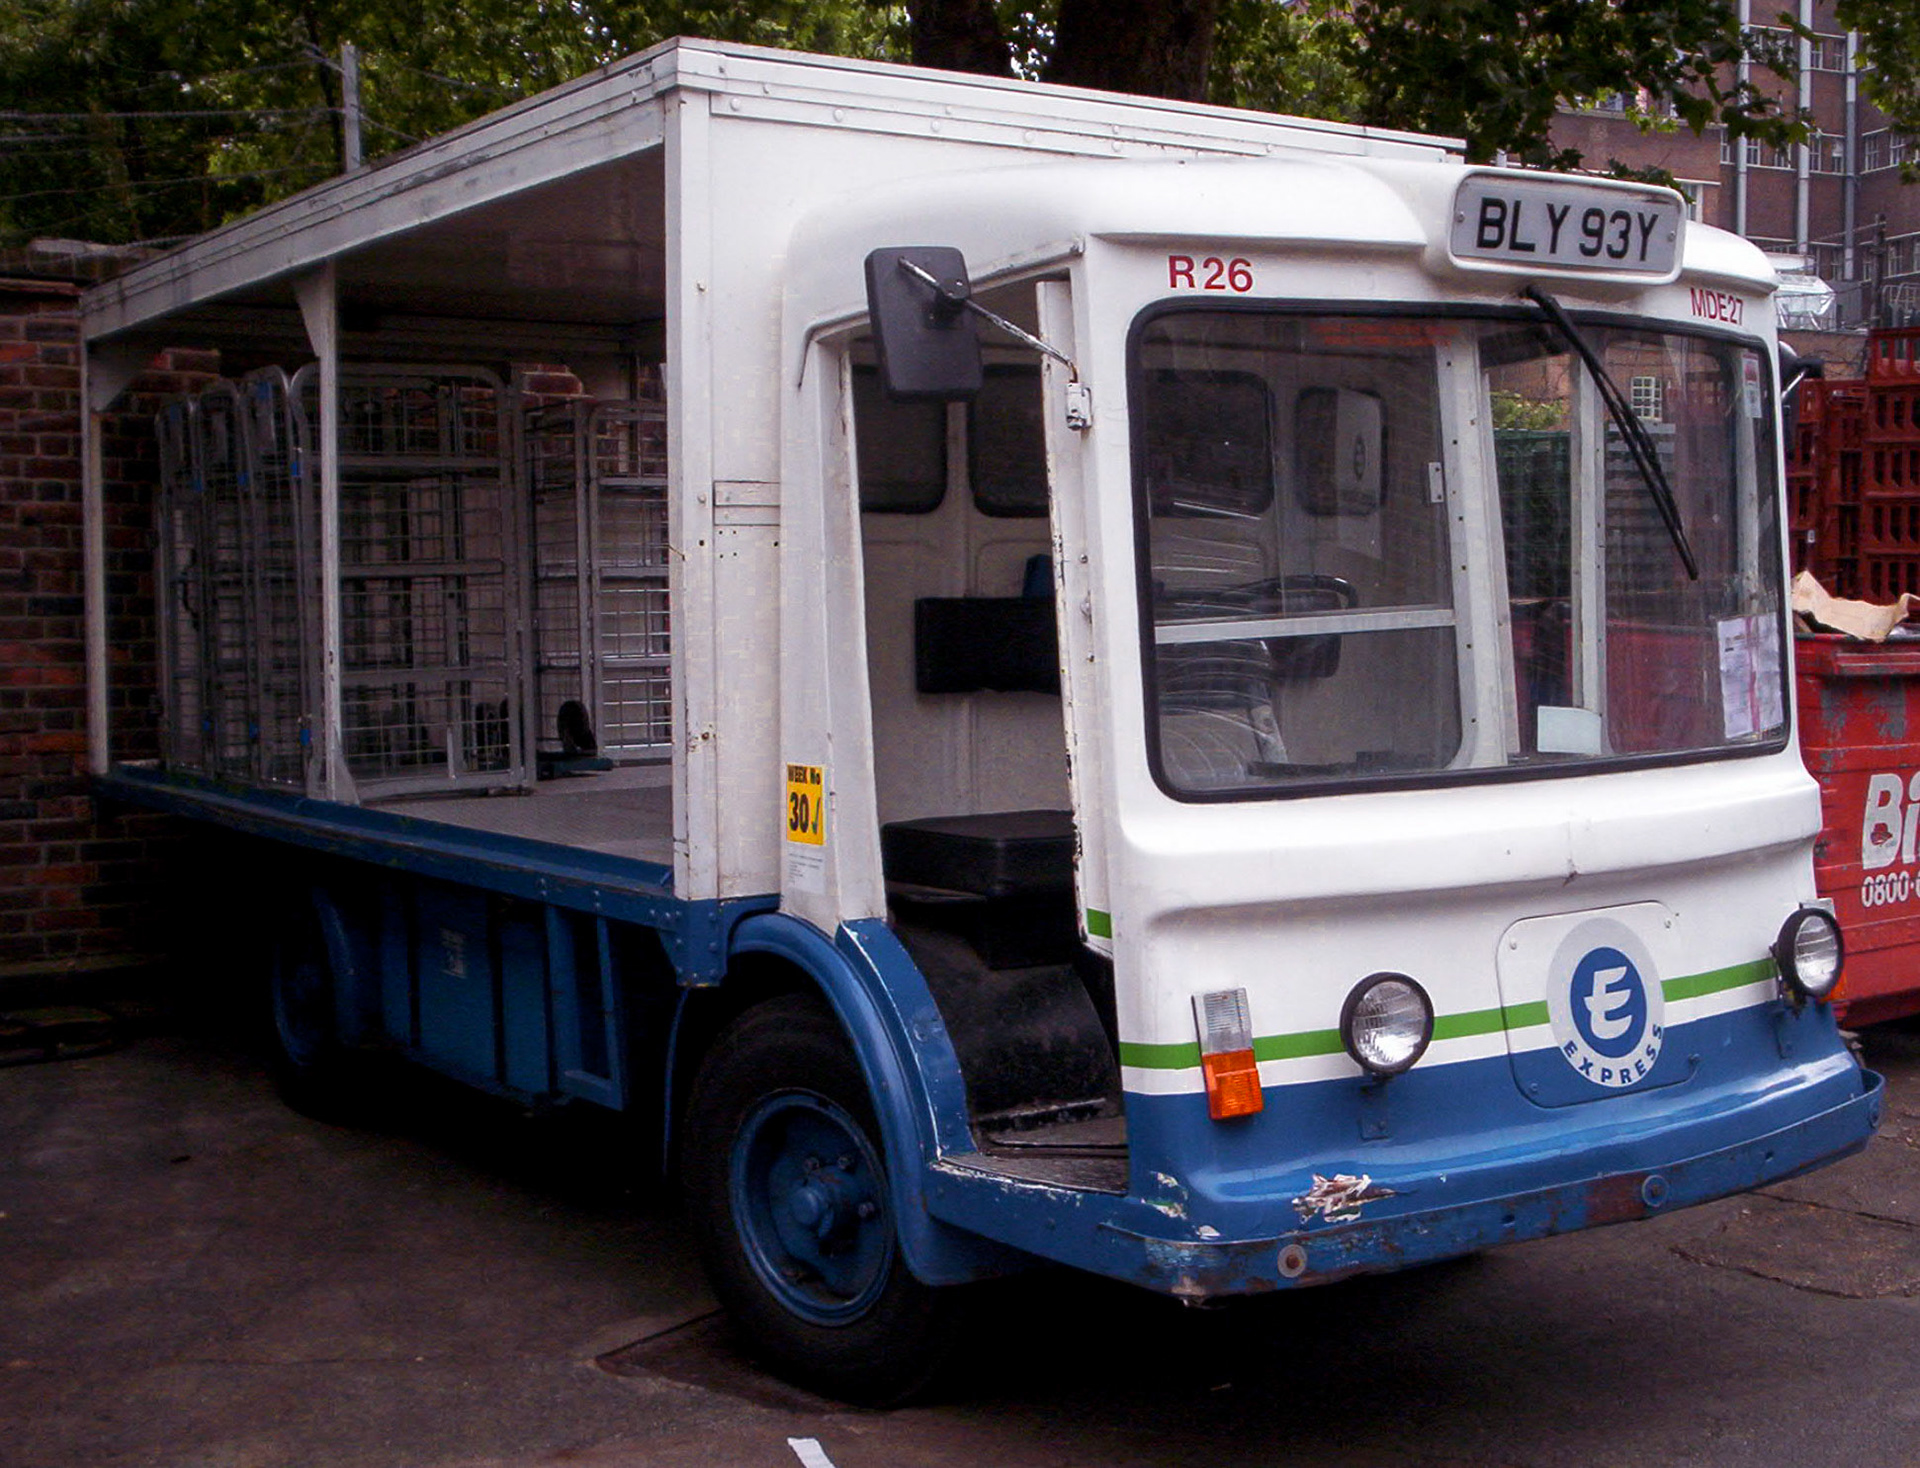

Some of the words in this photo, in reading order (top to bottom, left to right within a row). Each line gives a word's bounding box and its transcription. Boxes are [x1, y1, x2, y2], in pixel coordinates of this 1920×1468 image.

[1476, 196, 1571, 254] BLY
[1579, 207, 1659, 262] 93Y
[1168, 254, 1254, 293] R26
[1689, 286, 1744, 326] MDE27
[1563, 1024, 1663, 1084] EXPRESS
